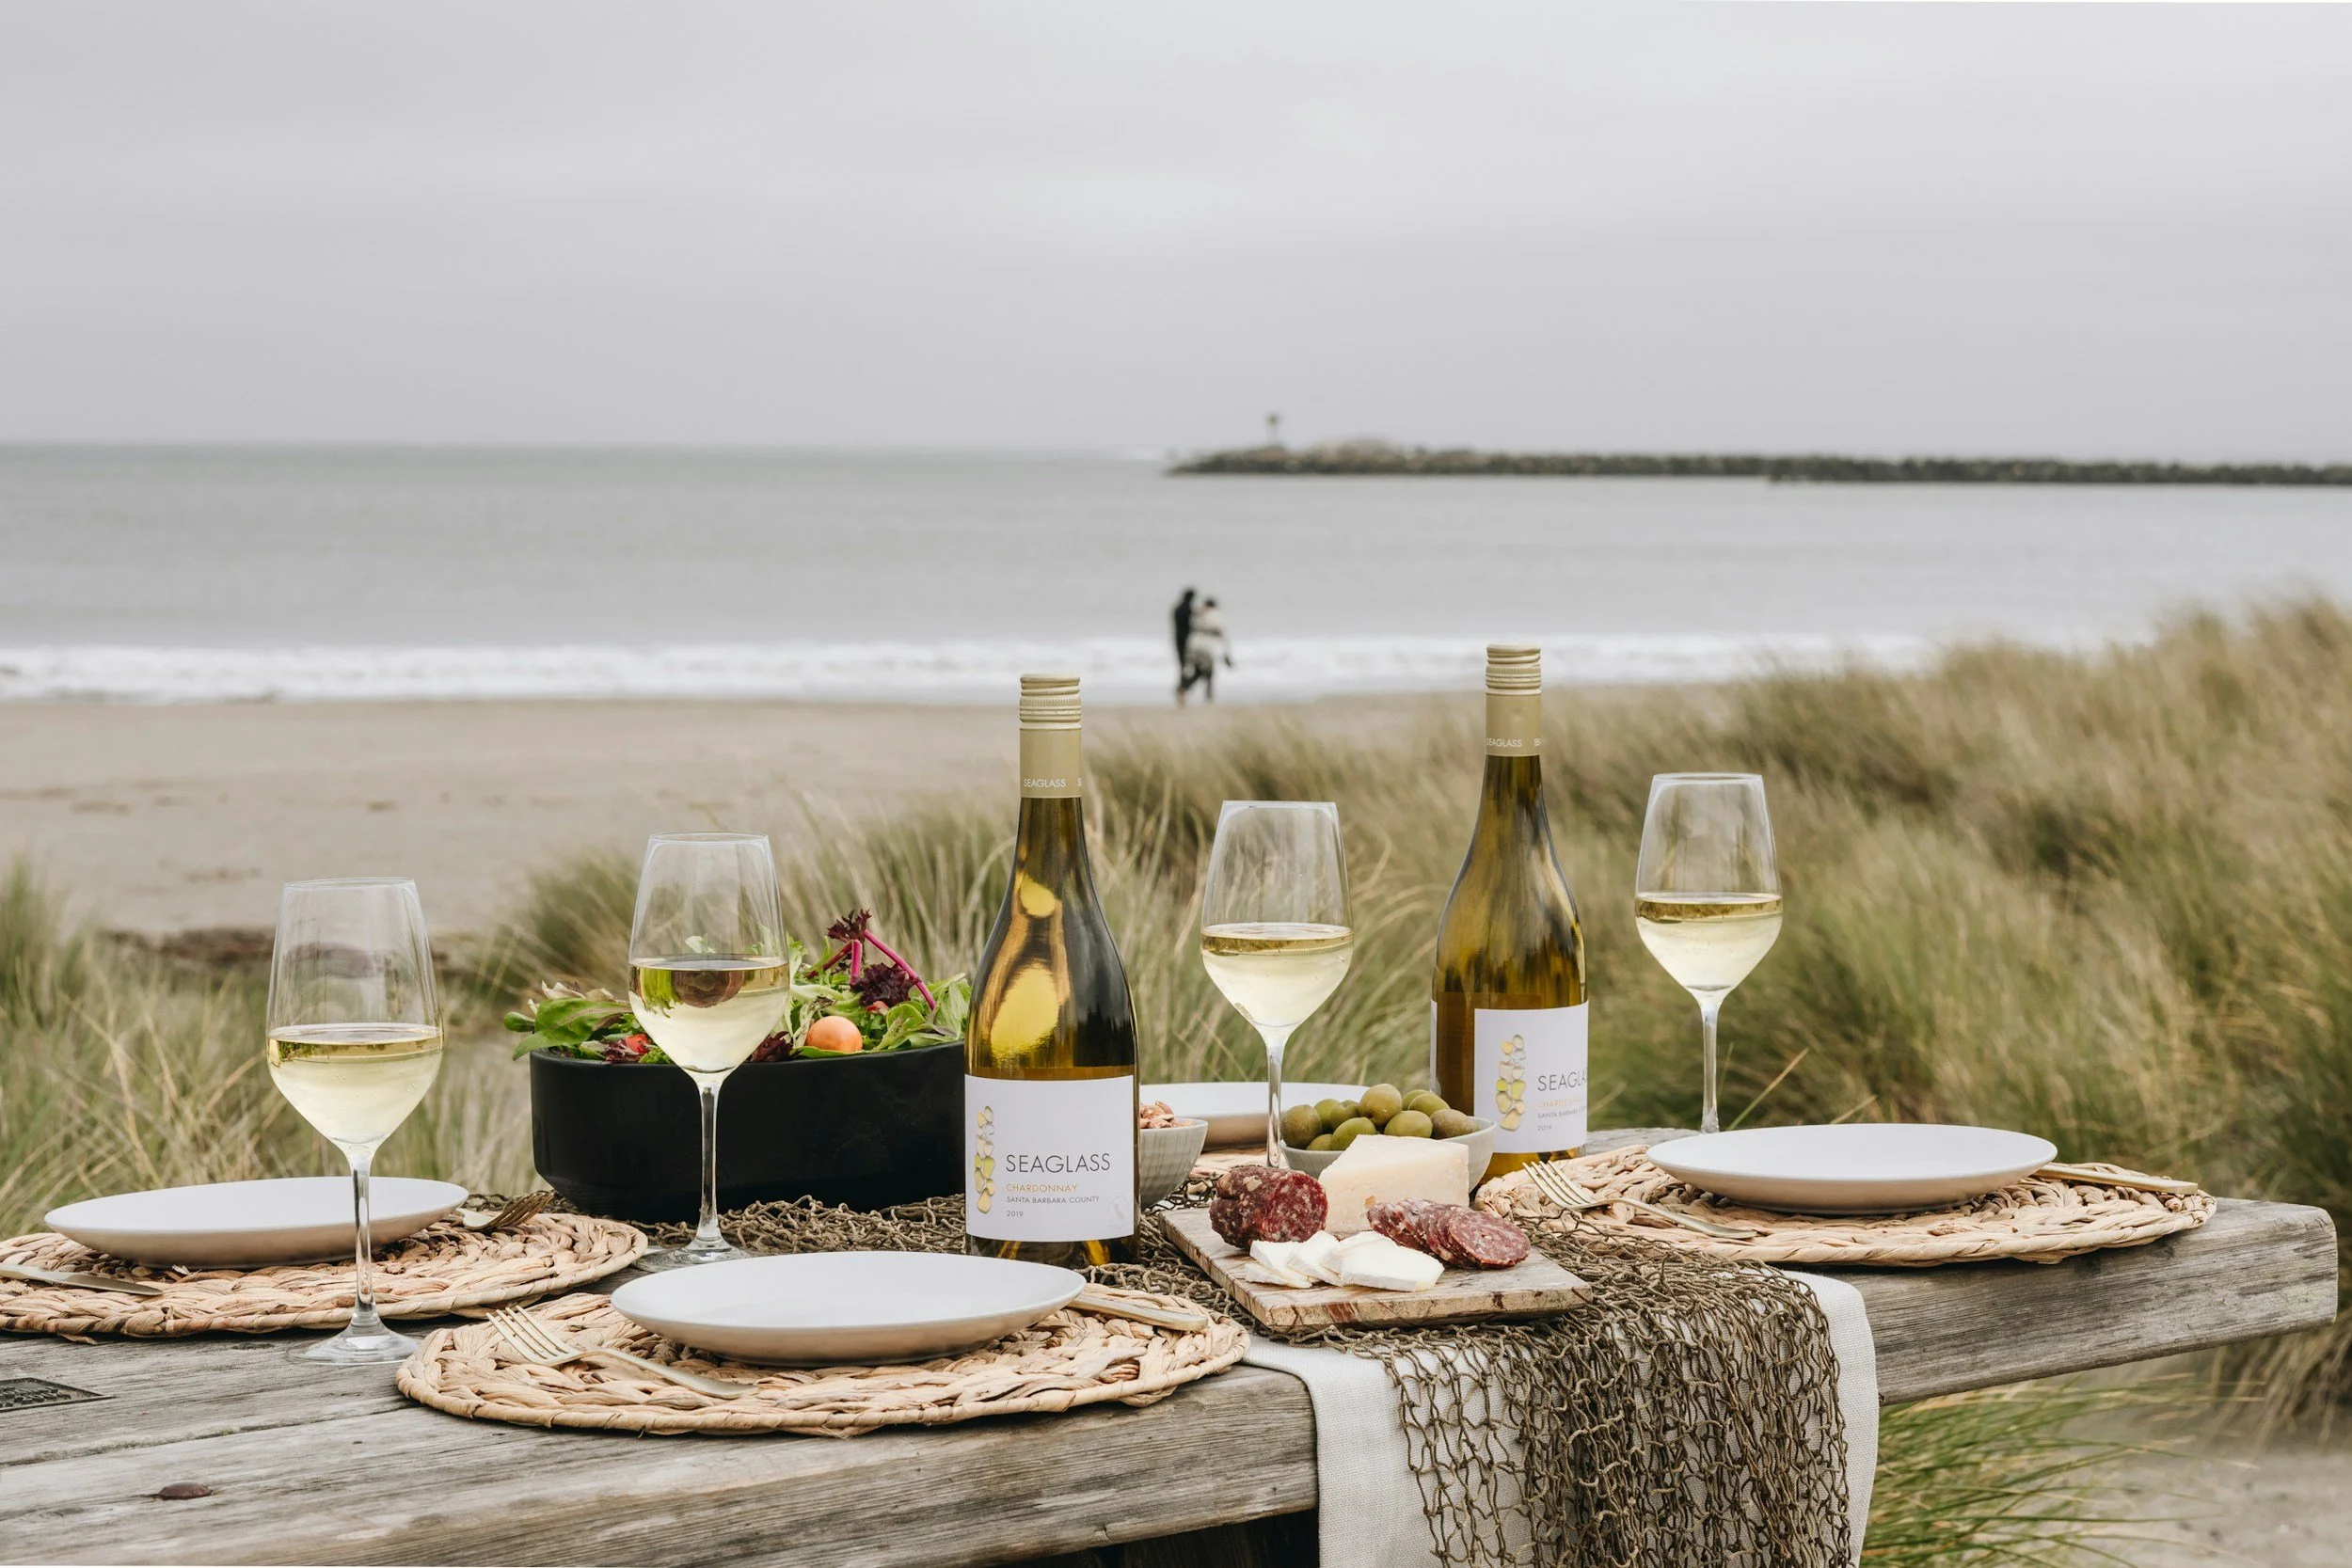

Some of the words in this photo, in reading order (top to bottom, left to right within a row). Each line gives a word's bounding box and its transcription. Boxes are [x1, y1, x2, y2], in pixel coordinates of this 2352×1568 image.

[1024, 778, 1067, 788] SEAGLASS
[1006, 1152, 1111, 1174] SEAGLASS
[1006, 1183, 1078, 1193] CHARDONNAY
[1007, 1196, 1030, 1204] SANTA
[1032, 1196, 1067, 1205] BARBARA
[1069, 1196, 1100, 1204] COUNTY
[1007, 1210, 1024, 1218] 2019
